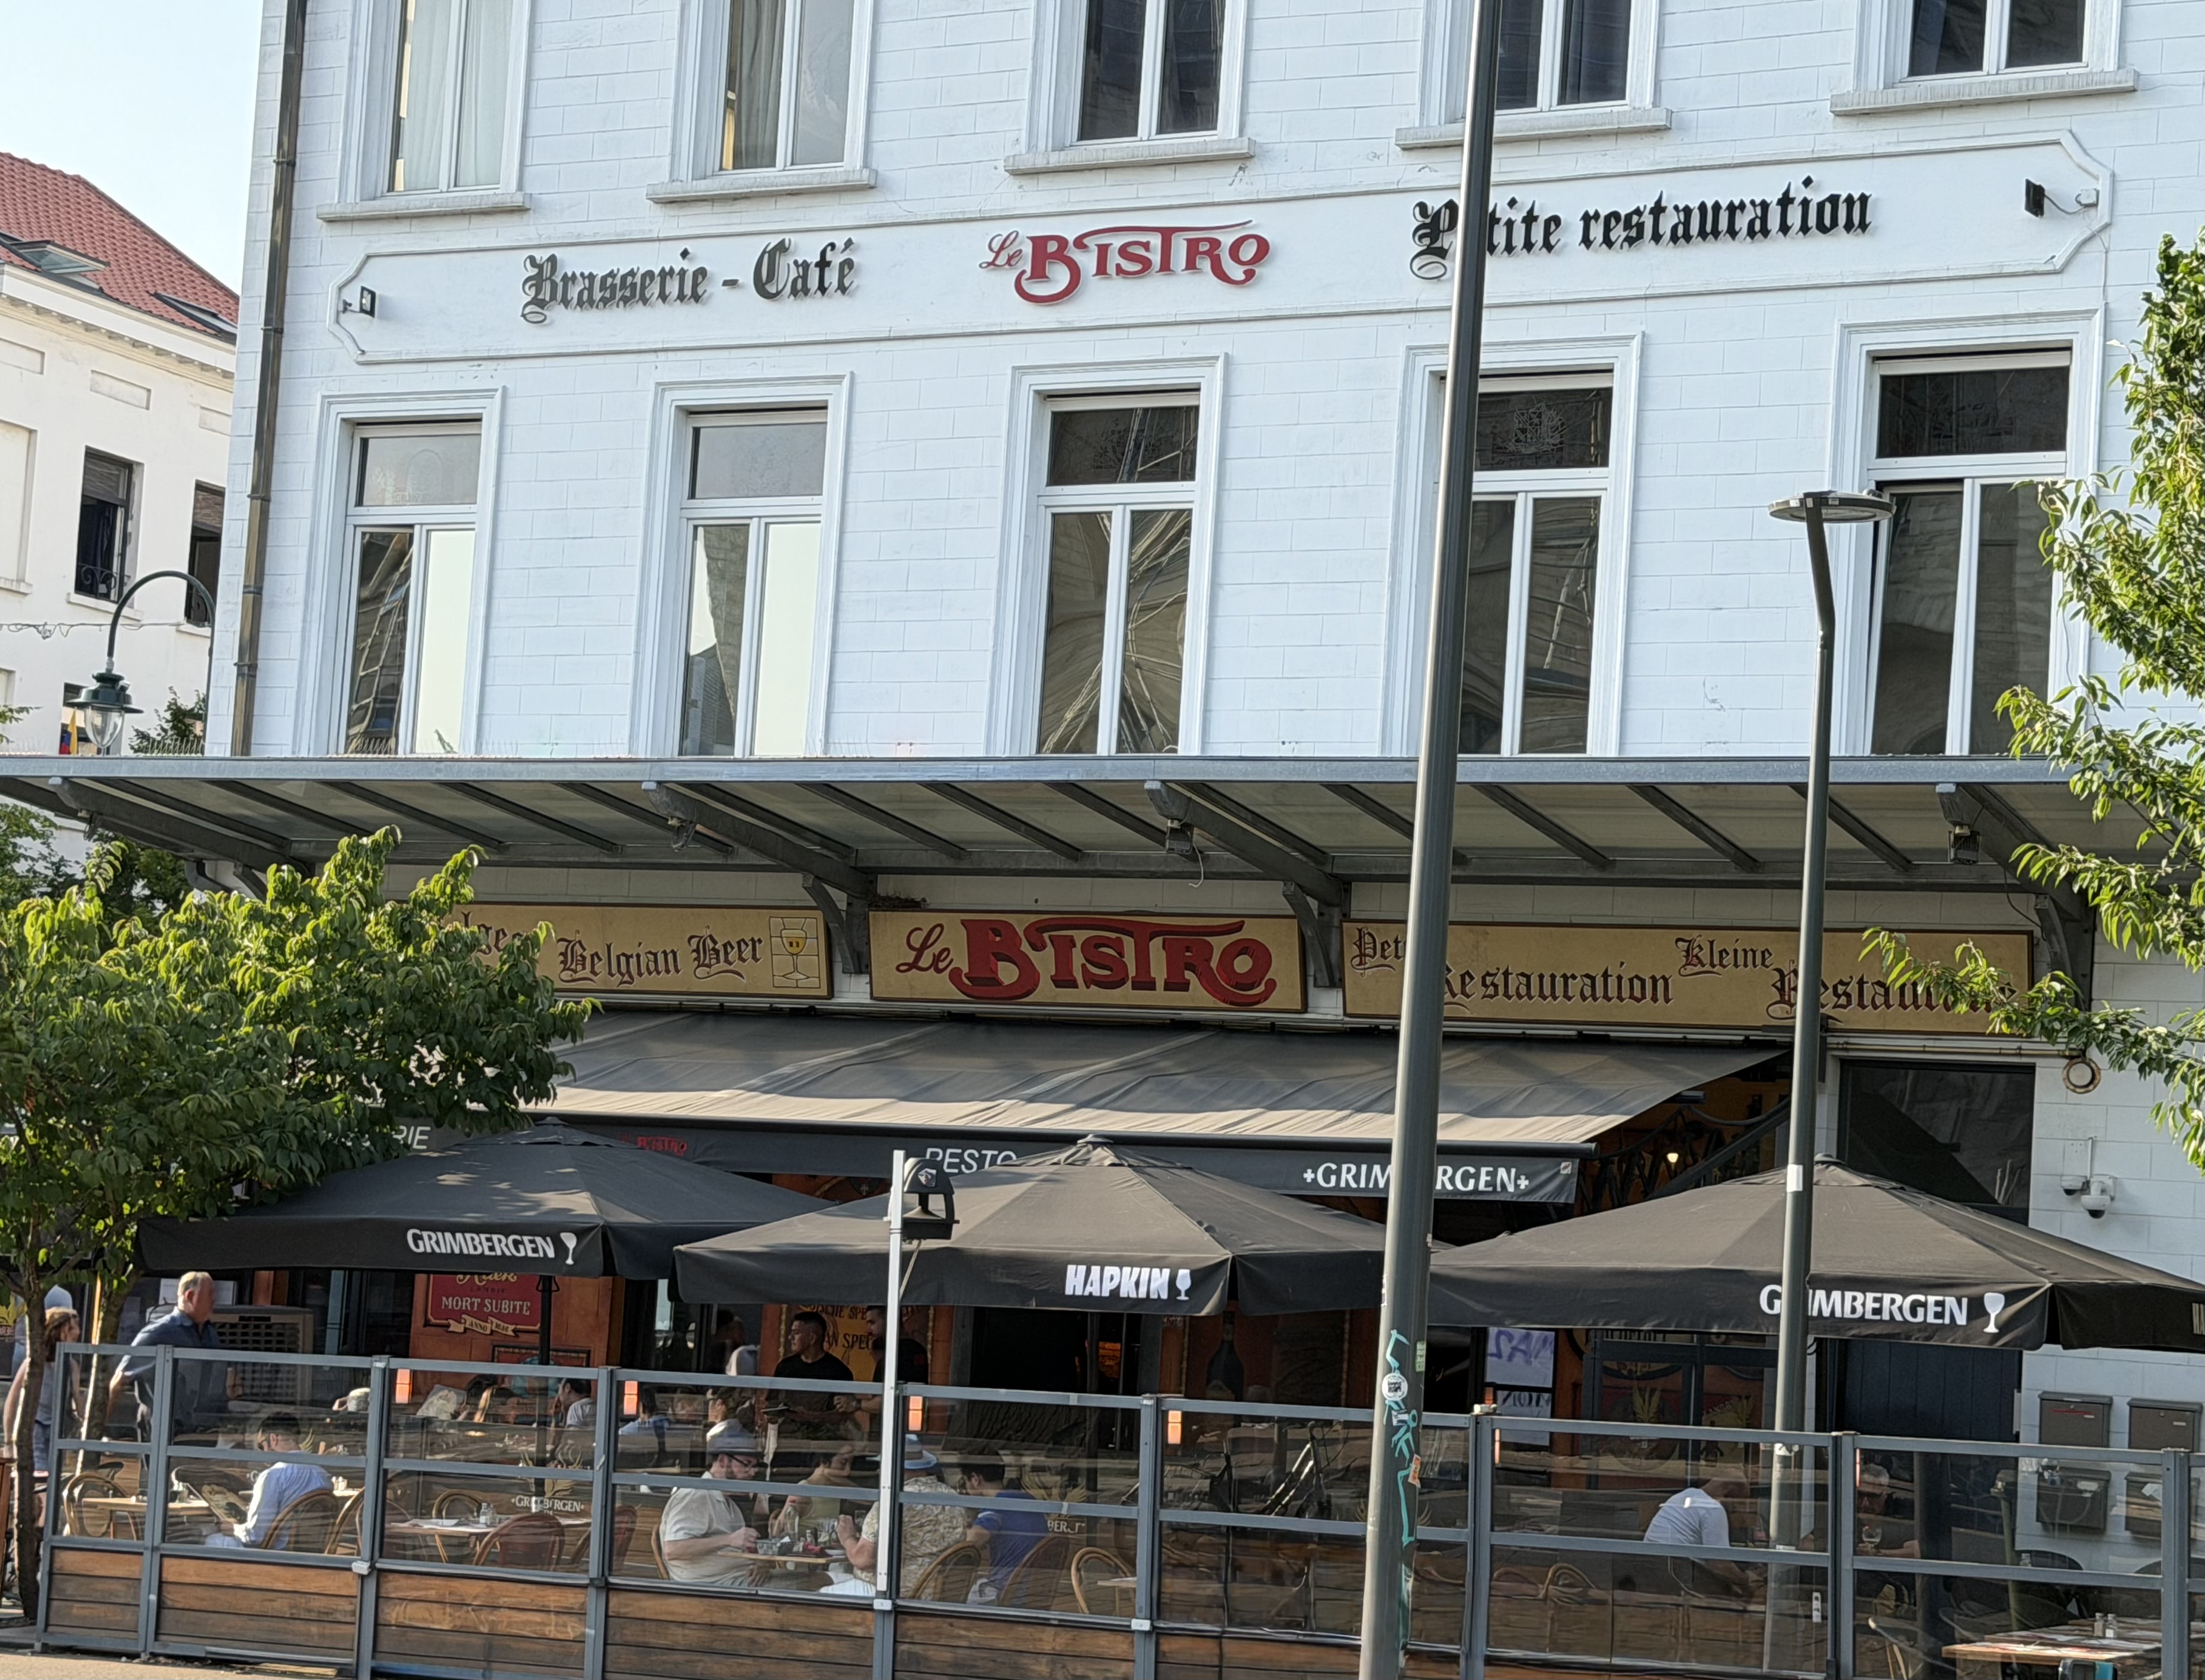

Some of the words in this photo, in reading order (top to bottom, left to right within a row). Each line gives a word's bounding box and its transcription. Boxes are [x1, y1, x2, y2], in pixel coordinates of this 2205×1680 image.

[1409, 196, 1562, 280] Ptite
[1578, 175, 1873, 251] restauration
[521, 248, 707, 324] Brasserie
[753, 237, 855, 300] Café
[979, 231, 1022, 269] Le
[1014, 220, 1270, 305] BISTRO
[557, 930, 682, 988] Belgian
[687, 924, 764, 983] Beer
[895, 923, 954, 974] Le
[948, 917, 1278, 1006] BISTRO
[1675, 933, 1775, 977] Kleine
[1315, 1161, 1518, 1193] GRIMRGEN
[407, 1228, 555, 1259] GRIMBERGEN
[1065, 1264, 1171, 1300] HAPKIN
[441, 1296, 481, 1313] MORT
[484, 1299, 531, 1316] SUBITE
[468, 1320, 488, 1333] ANNO
[1758, 1284, 1969, 1327] GIMBERGEN
